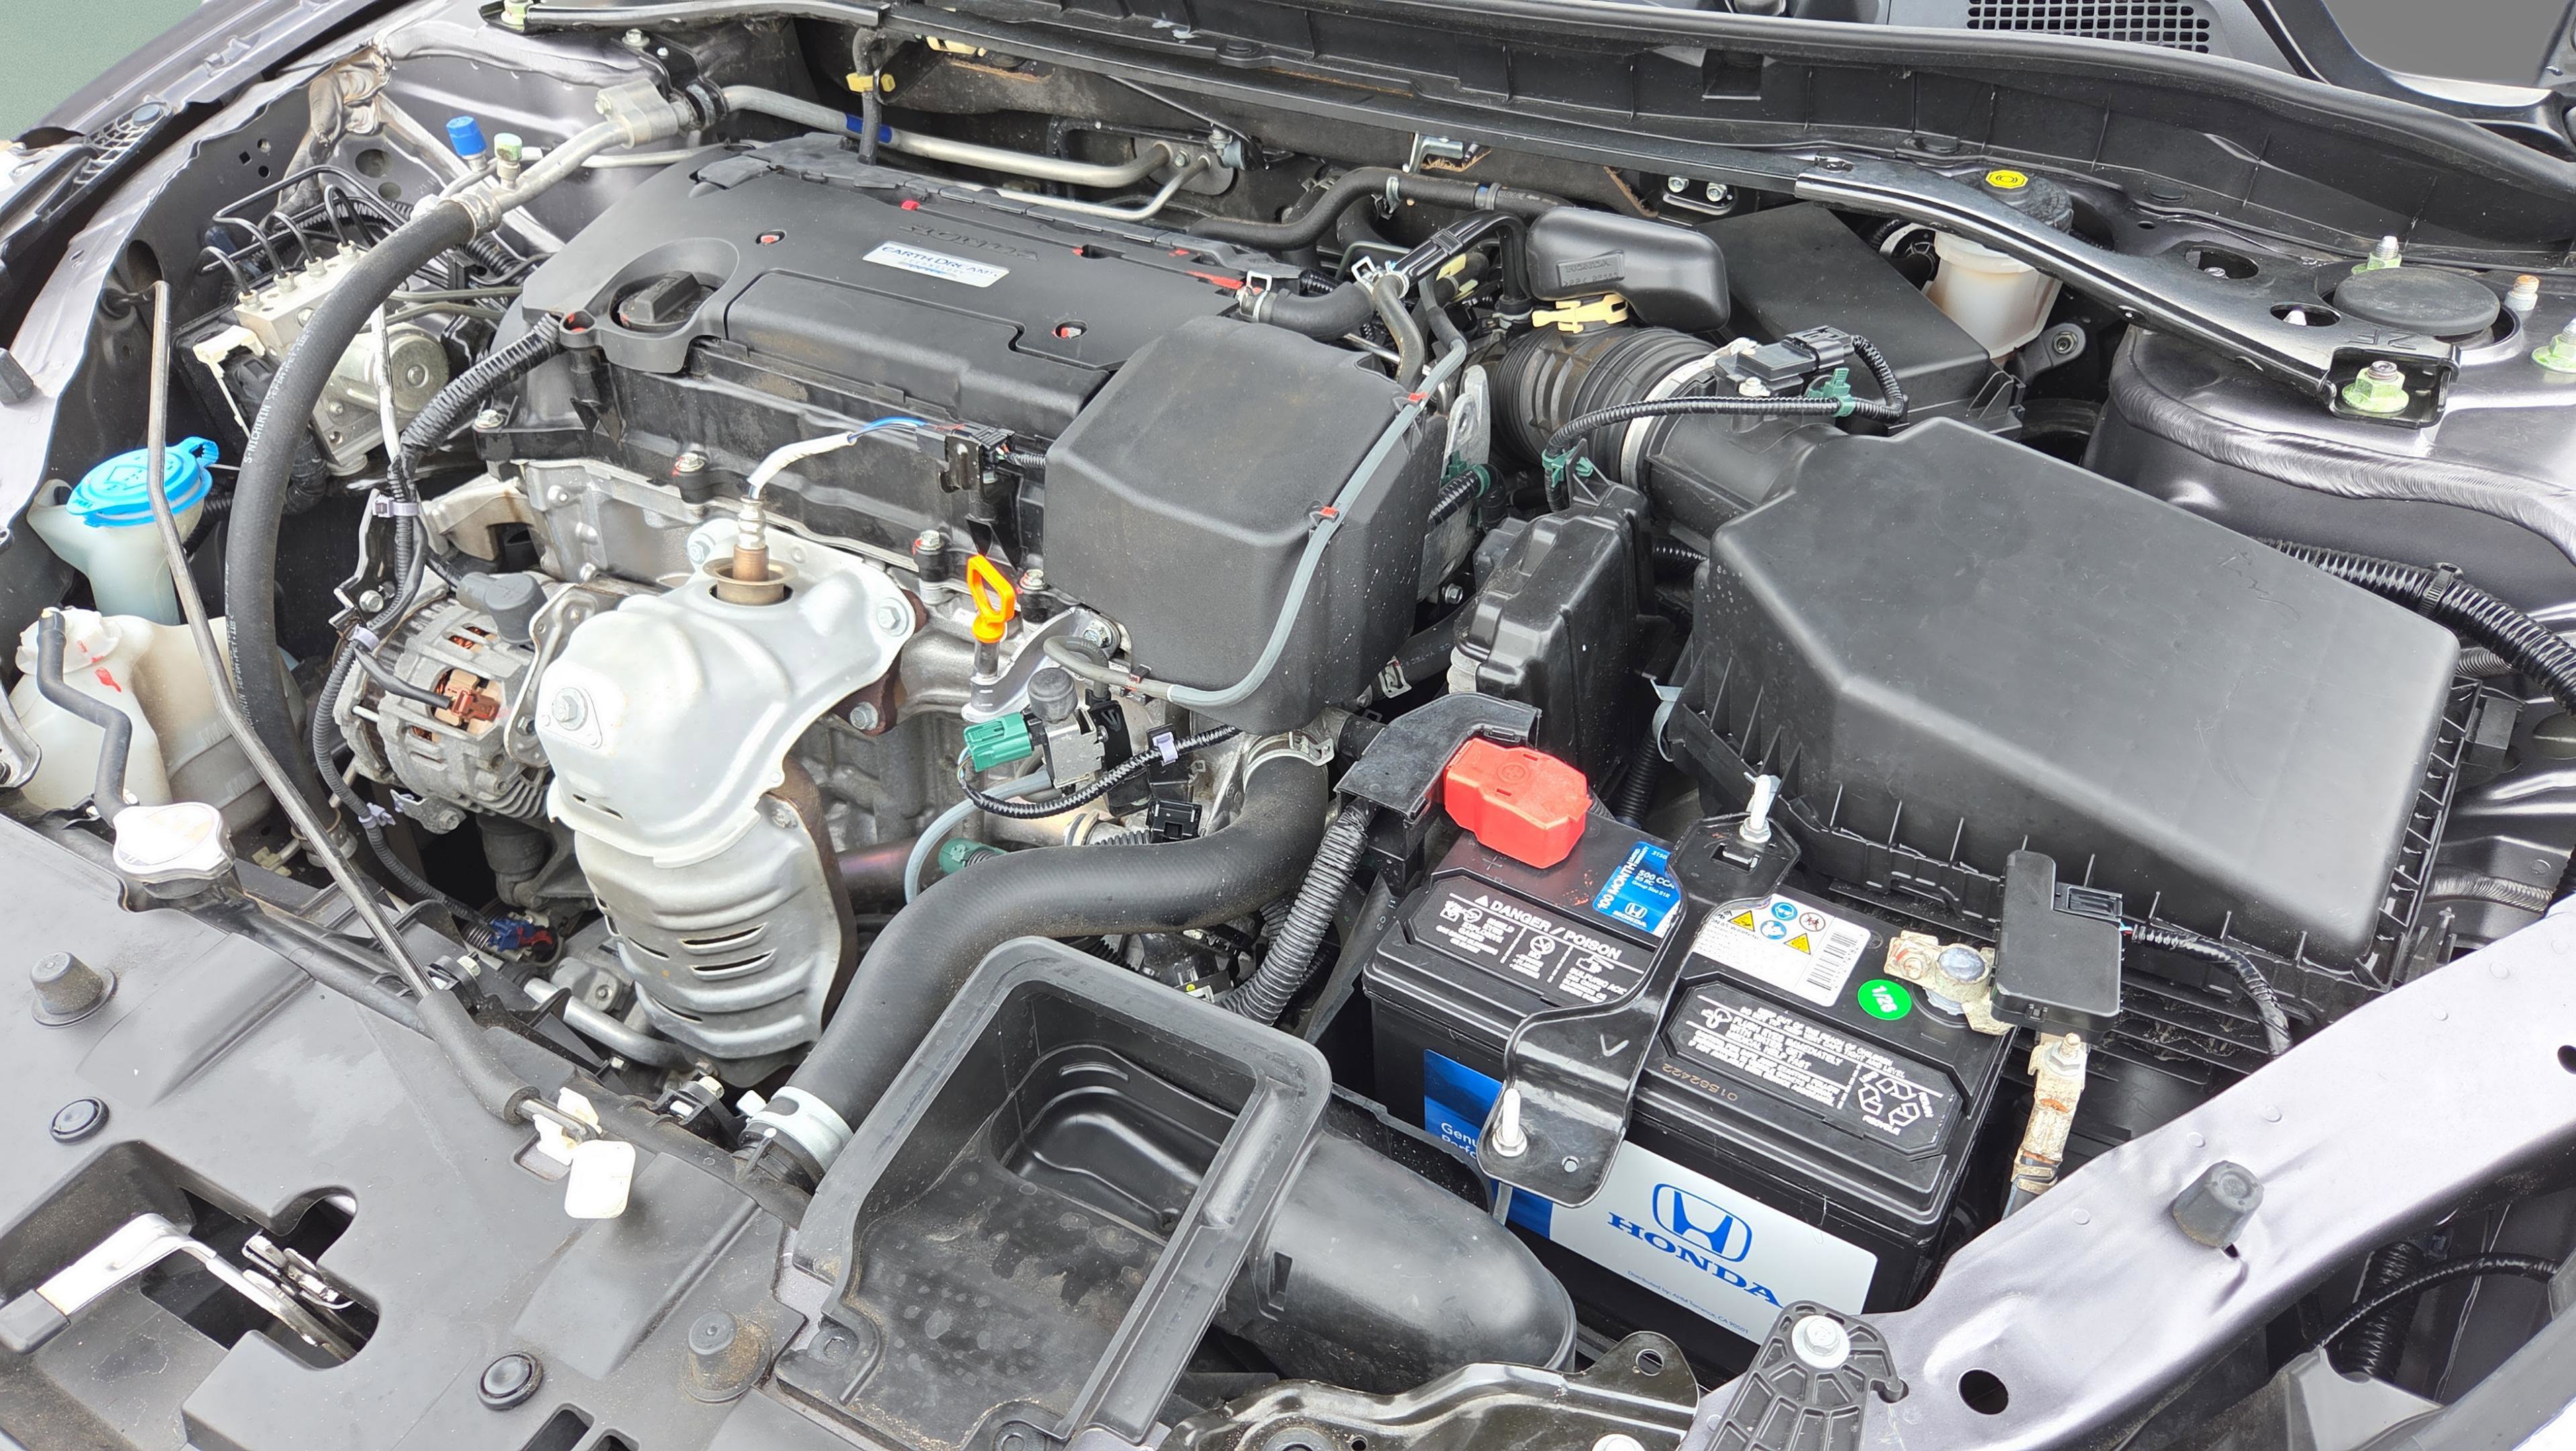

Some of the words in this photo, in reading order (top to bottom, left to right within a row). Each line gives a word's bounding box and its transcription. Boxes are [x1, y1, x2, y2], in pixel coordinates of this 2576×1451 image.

[882, 247, 933, 263] EARTH
[899, 224, 1040, 262] HONDA
[1598, 893, 1614, 910] 100
[1607, 862, 1637, 898] MONTH
[1638, 870, 1655, 880] 500
[1489, 901, 1551, 931] DANGER
[1563, 930, 1622, 960] POISON
[1441, 1123, 1477, 1147] Genu
[1607, 1212, 1784, 1309] HONDA
